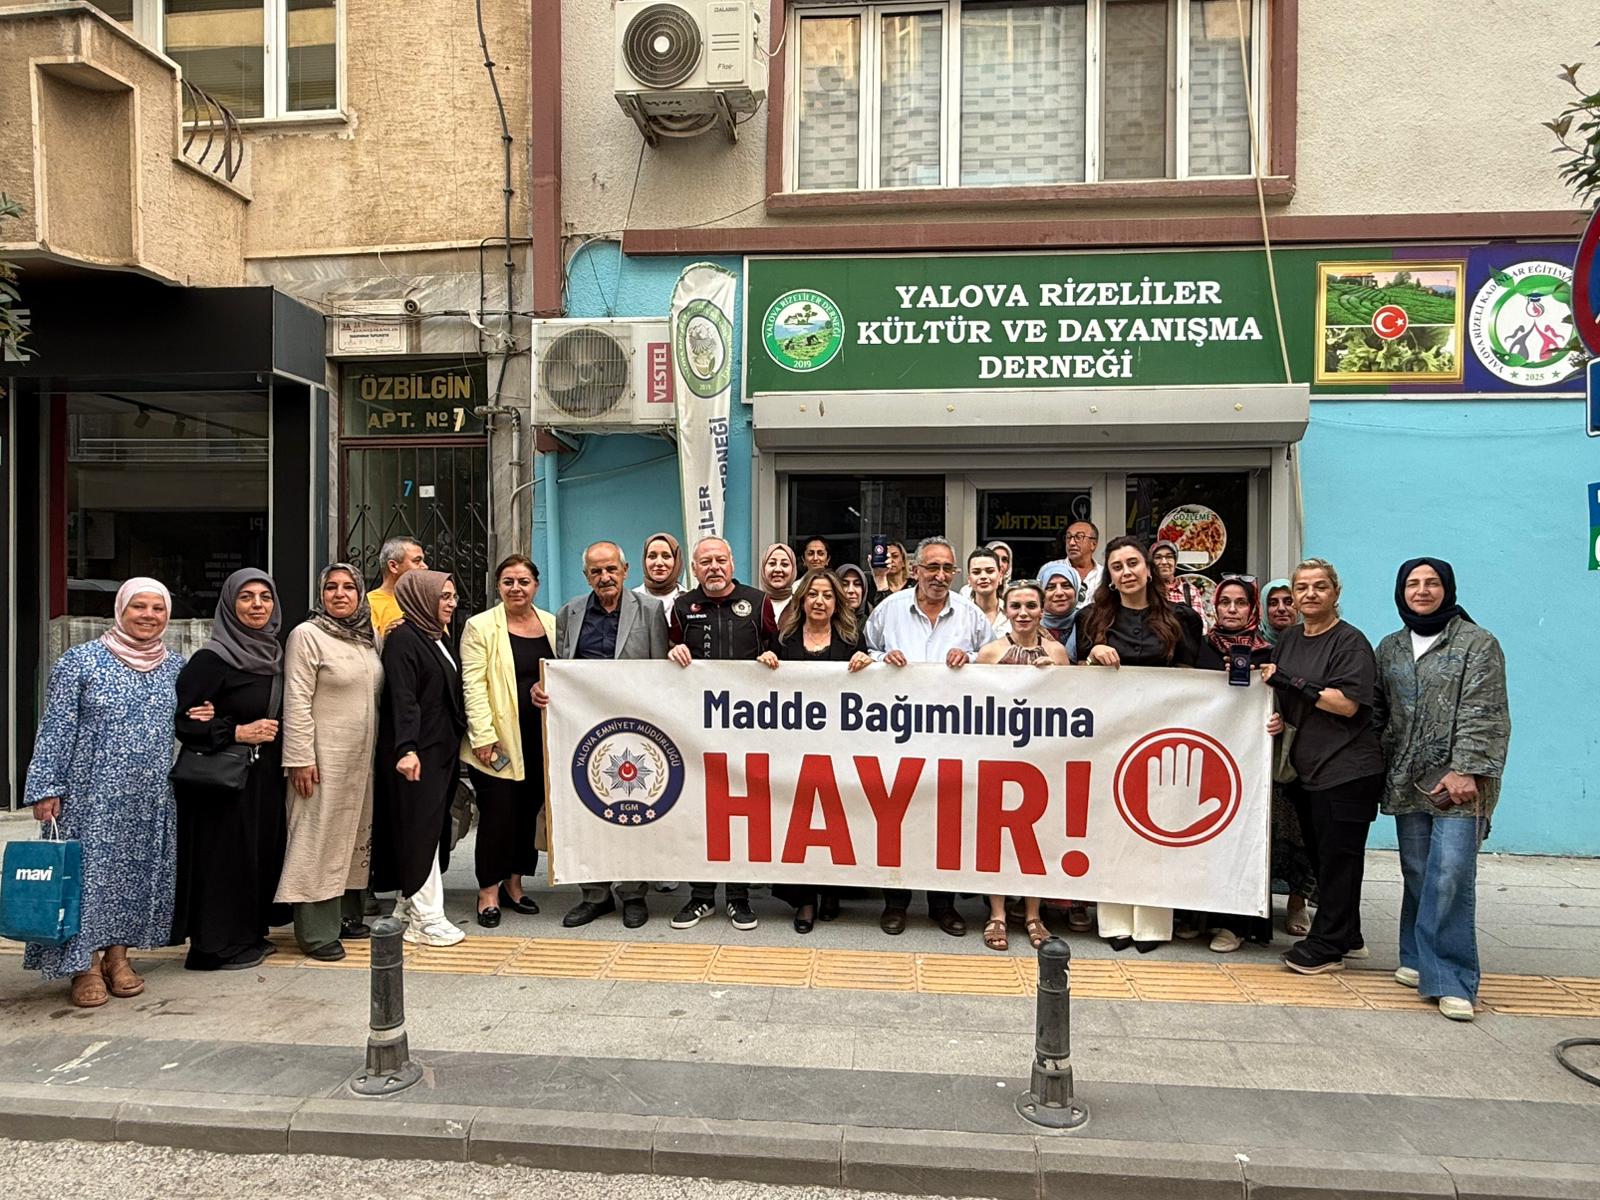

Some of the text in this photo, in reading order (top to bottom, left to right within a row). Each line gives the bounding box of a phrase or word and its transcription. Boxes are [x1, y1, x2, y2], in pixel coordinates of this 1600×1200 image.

[895, 276, 1222, 309] YALOVA RİZELİLER
[766, 307, 782, 338] YALOVA
[857, 315, 1262, 347] KÜLTÜR VE DAYANIŞMA
[653, 344, 668, 402] VESTEL
[793, 360, 812, 369] 2019
[978, 348, 1133, 379] DERNEĞİ
[1525, 373, 1545, 381] 2025
[361, 373, 471, 400] ÖZBİLGİN
[368, 412, 415, 428] APT.
[404, 480, 412, 497] 7
[704, 690, 1094, 748] Madde Bağımlılığına
[576, 721, 681, 767] YALOVA EMNİYET MÜDÜRLÜĞÜ
[620, 803, 639, 811] EGM
[703, 752, 1092, 878] HAYIR!
[15, 866, 54, 880] mavi
